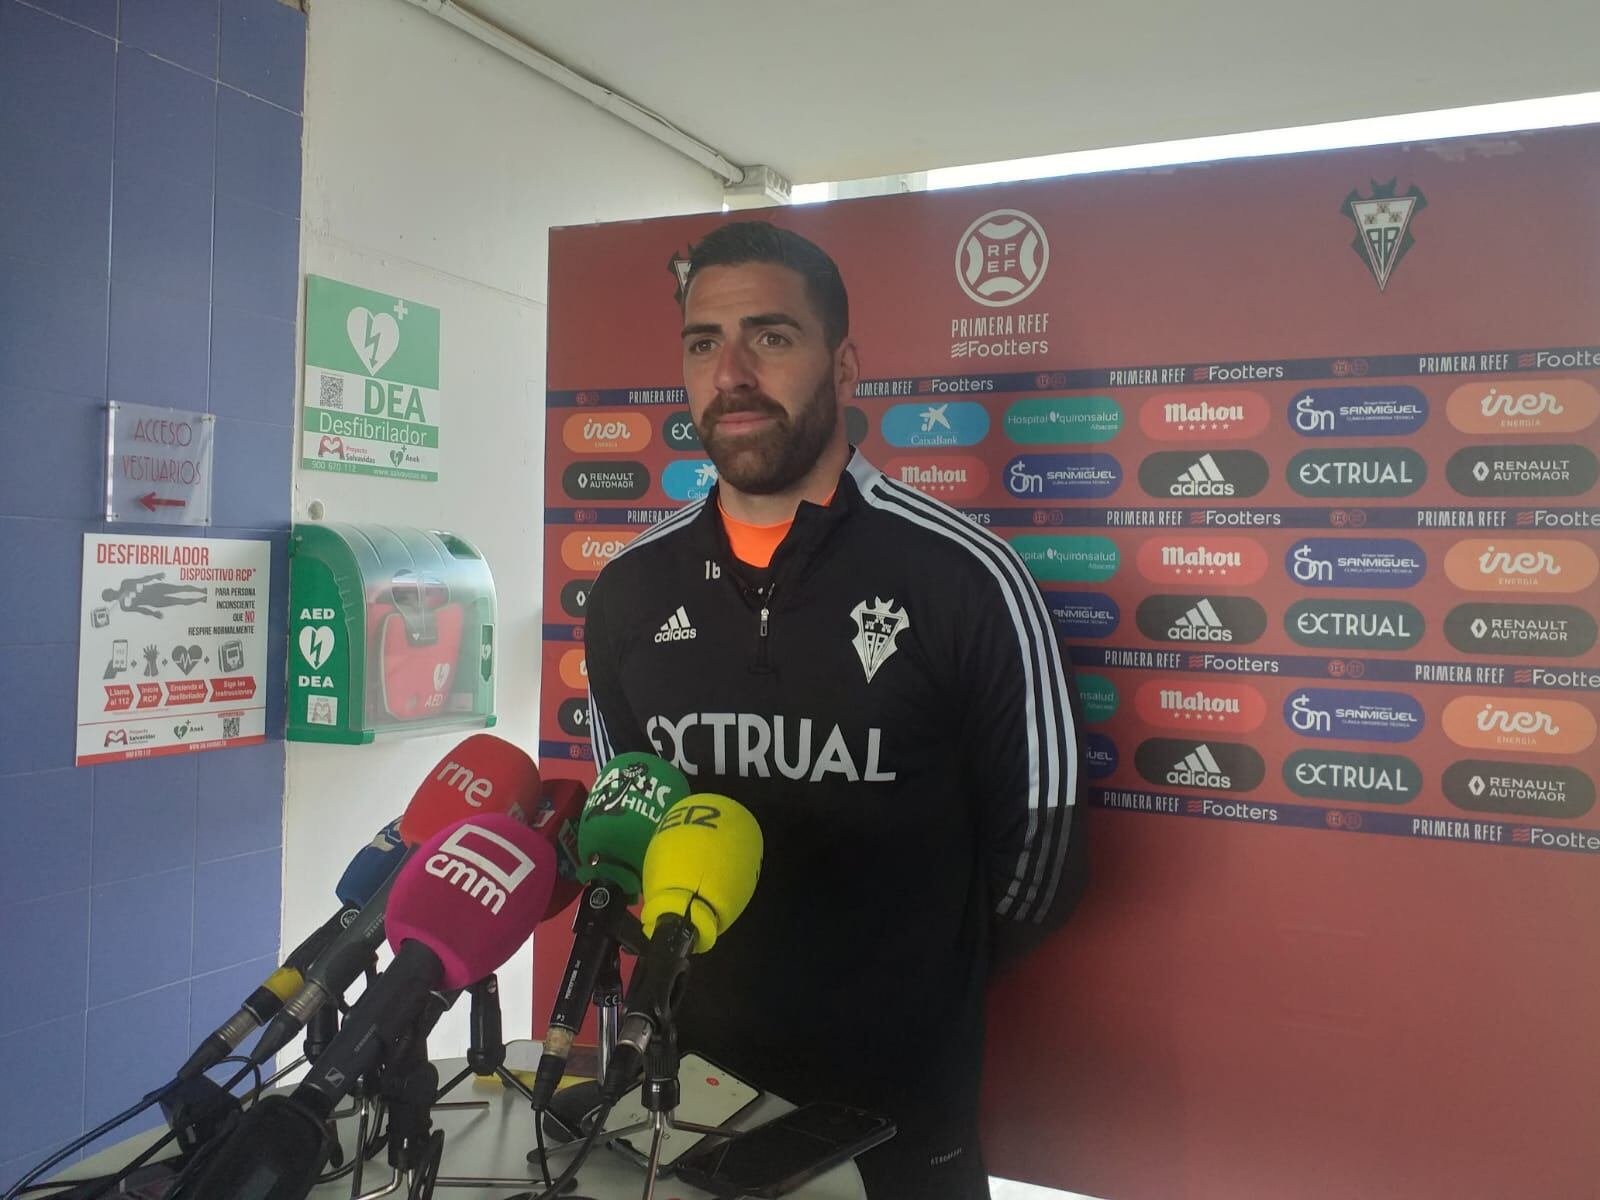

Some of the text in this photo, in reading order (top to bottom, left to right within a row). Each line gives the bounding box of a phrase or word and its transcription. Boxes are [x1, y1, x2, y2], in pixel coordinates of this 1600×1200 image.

[952, 313, 1049, 338] PRIMERA RFEF
[968, 339, 1049, 357] Footters
[1419, 354, 1509, 373] PRIMERA RFEF
[1110, 368, 1186, 386] PRIMERA RFEF
[1209, 364, 1284, 381] Footters
[892, 381, 912, 395] RFEF
[932, 378, 994, 393] Footters
[365, 380, 426, 423] DEA
[629, 390, 684, 404] PRIMERA RFEF
[1164, 402, 1244, 422] Mahou
[1340, 404, 1422, 416] SANMIGUEL
[1008, 416, 1048, 425] Hospital
[134, 418, 193, 447] ACCESO
[320, 412, 426, 446] Desfibrilador
[910, 435, 958, 446] CaixaBank
[122, 455, 201, 484] VESTUARIOS
[1299, 461, 1413, 484] EXTRUAL
[1494, 460, 1570, 470] RENAULT
[901, 464, 968, 483] Mahou
[1047, 471, 1116, 480] SANMIGUEL
[1494, 471, 1570, 481] AUTOMAOR
[1170, 480, 1235, 496] adidas
[627, 510, 662, 524] PRIMERA
[1107, 511, 1183, 526] PRIMERA RFEF
[1206, 510, 1281, 525] Footters
[1418, 511, 1507, 527] PRIMERA RFEF
[97, 543, 209, 566] DESFIBRILADOR
[1161, 545, 1242, 567] Mahou
[1338, 557, 1419, 567] SANMIGUEL
[180, 568, 233, 581] DISPOSITIVO
[215, 588, 255, 596] PARA PERSONA
[216, 600, 255, 609] INCONSCIENTE
[233, 611, 255, 623] QUE NO
[300, 608, 335, 620] AED
[1053, 609, 1114, 619] ANMIGUEL
[188, 626, 254, 635] RESPIRE NORMALMENTE
[1297, 612, 1411, 638] EXTRUAL
[1491, 619, 1568, 631] RENAULT
[654, 627, 697, 643] adidas
[1168, 625, 1233, 642] adidas
[1491, 630, 1568, 641] AUTOMAOR
[1105, 651, 1181, 669] PRIMERA RFEF
[1204, 655, 1279, 672] Footters
[299, 676, 334, 688] DEA
[1415, 665, 1504, 684] PRIMERA RFEF
[1160, 689, 1240, 713] Mahou
[1336, 709, 1417, 722] SANMIGUEL
[647, 713, 896, 782] EXTRUAL
[437, 759, 493, 808] rne
[1167, 770, 1231, 789] adidas
[1296, 763, 1408, 791] EXTRUAL
[1489, 777, 1566, 791] RENAULT
[1104, 791, 1180, 813] PRIMERA RFEF
[1489, 789, 1566, 802] AUTOMAOR
[1203, 800, 1278, 821] Footters
[657, 805, 721, 834] ER
[1413, 819, 1503, 841] PRIMERA RFEF
[425, 854, 506, 915] cmm
